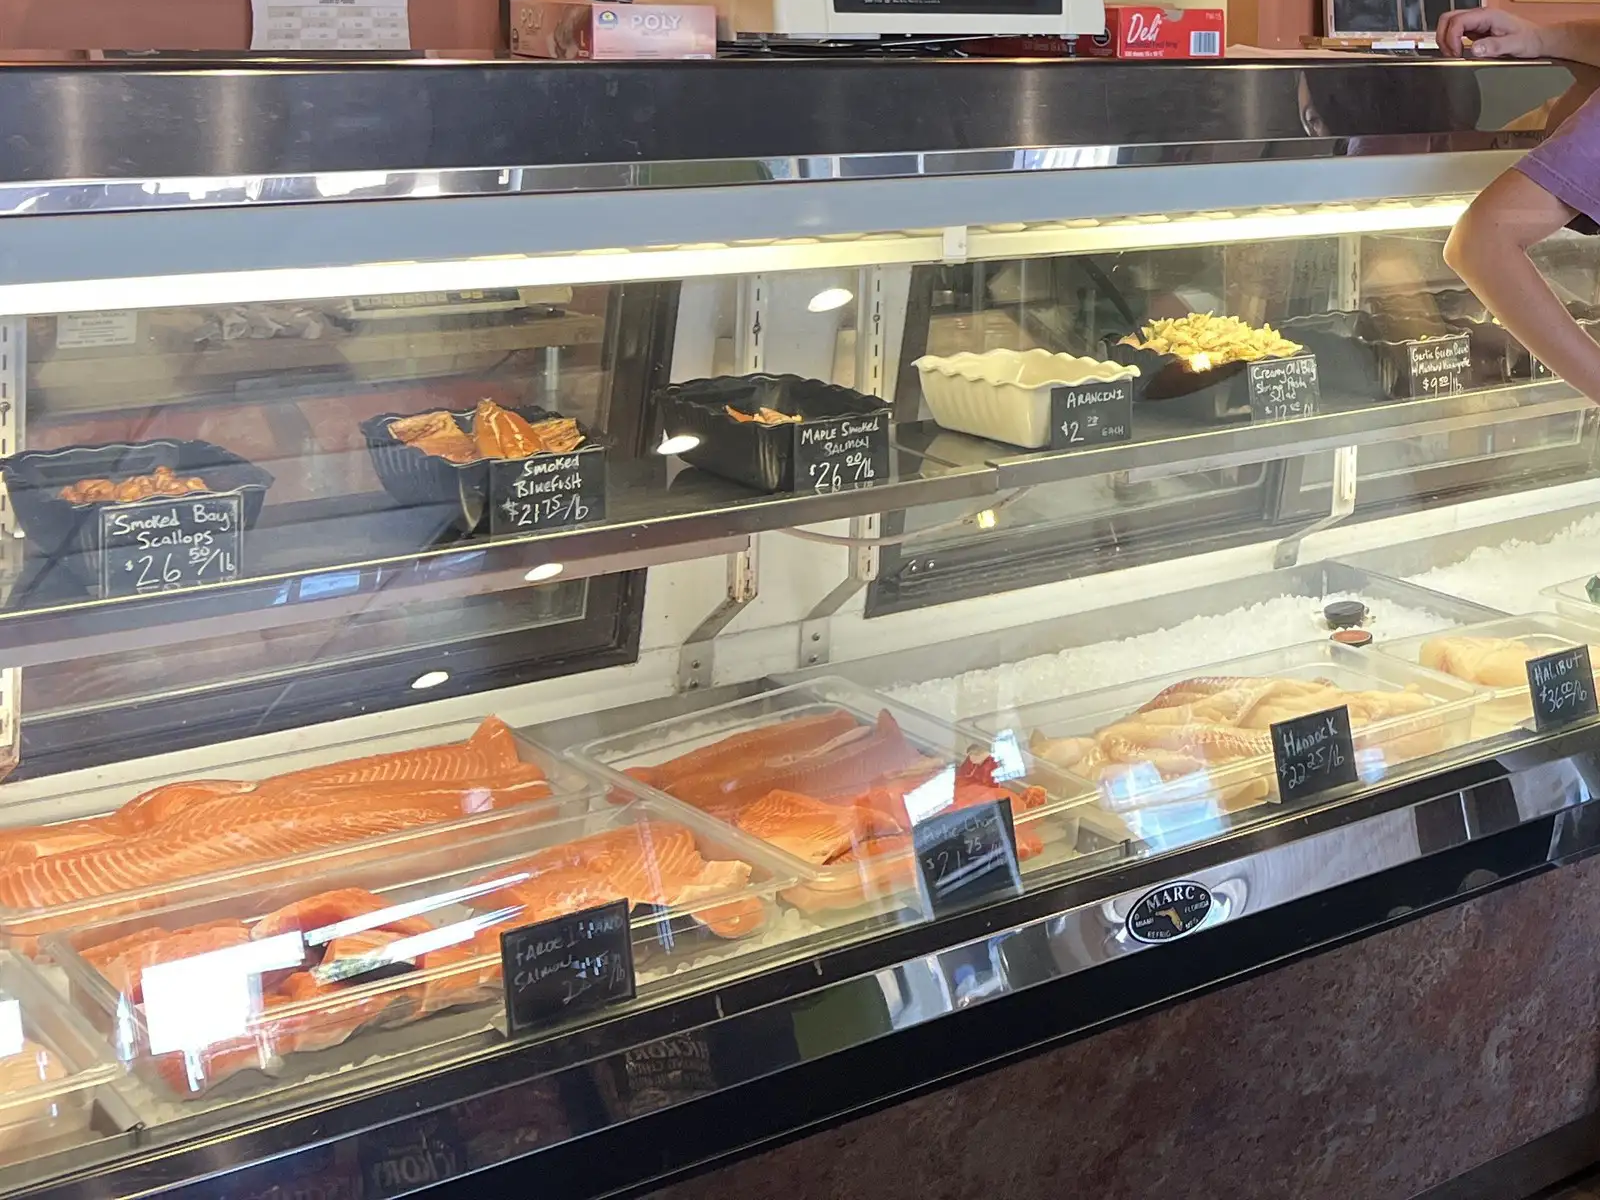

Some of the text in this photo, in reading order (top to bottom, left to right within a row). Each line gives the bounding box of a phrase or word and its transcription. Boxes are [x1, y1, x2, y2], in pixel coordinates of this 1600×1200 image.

[631, 13, 682, 30] POLY
[1127, 13, 1162, 44] Deli
[801, 428, 836, 445] MAPLE
[523, 455, 580, 477] Smoked
[112, 504, 231, 535] Smoked Bay
[136, 529, 214, 550] Scallops
[1146, 886, 1195, 913] MARC
